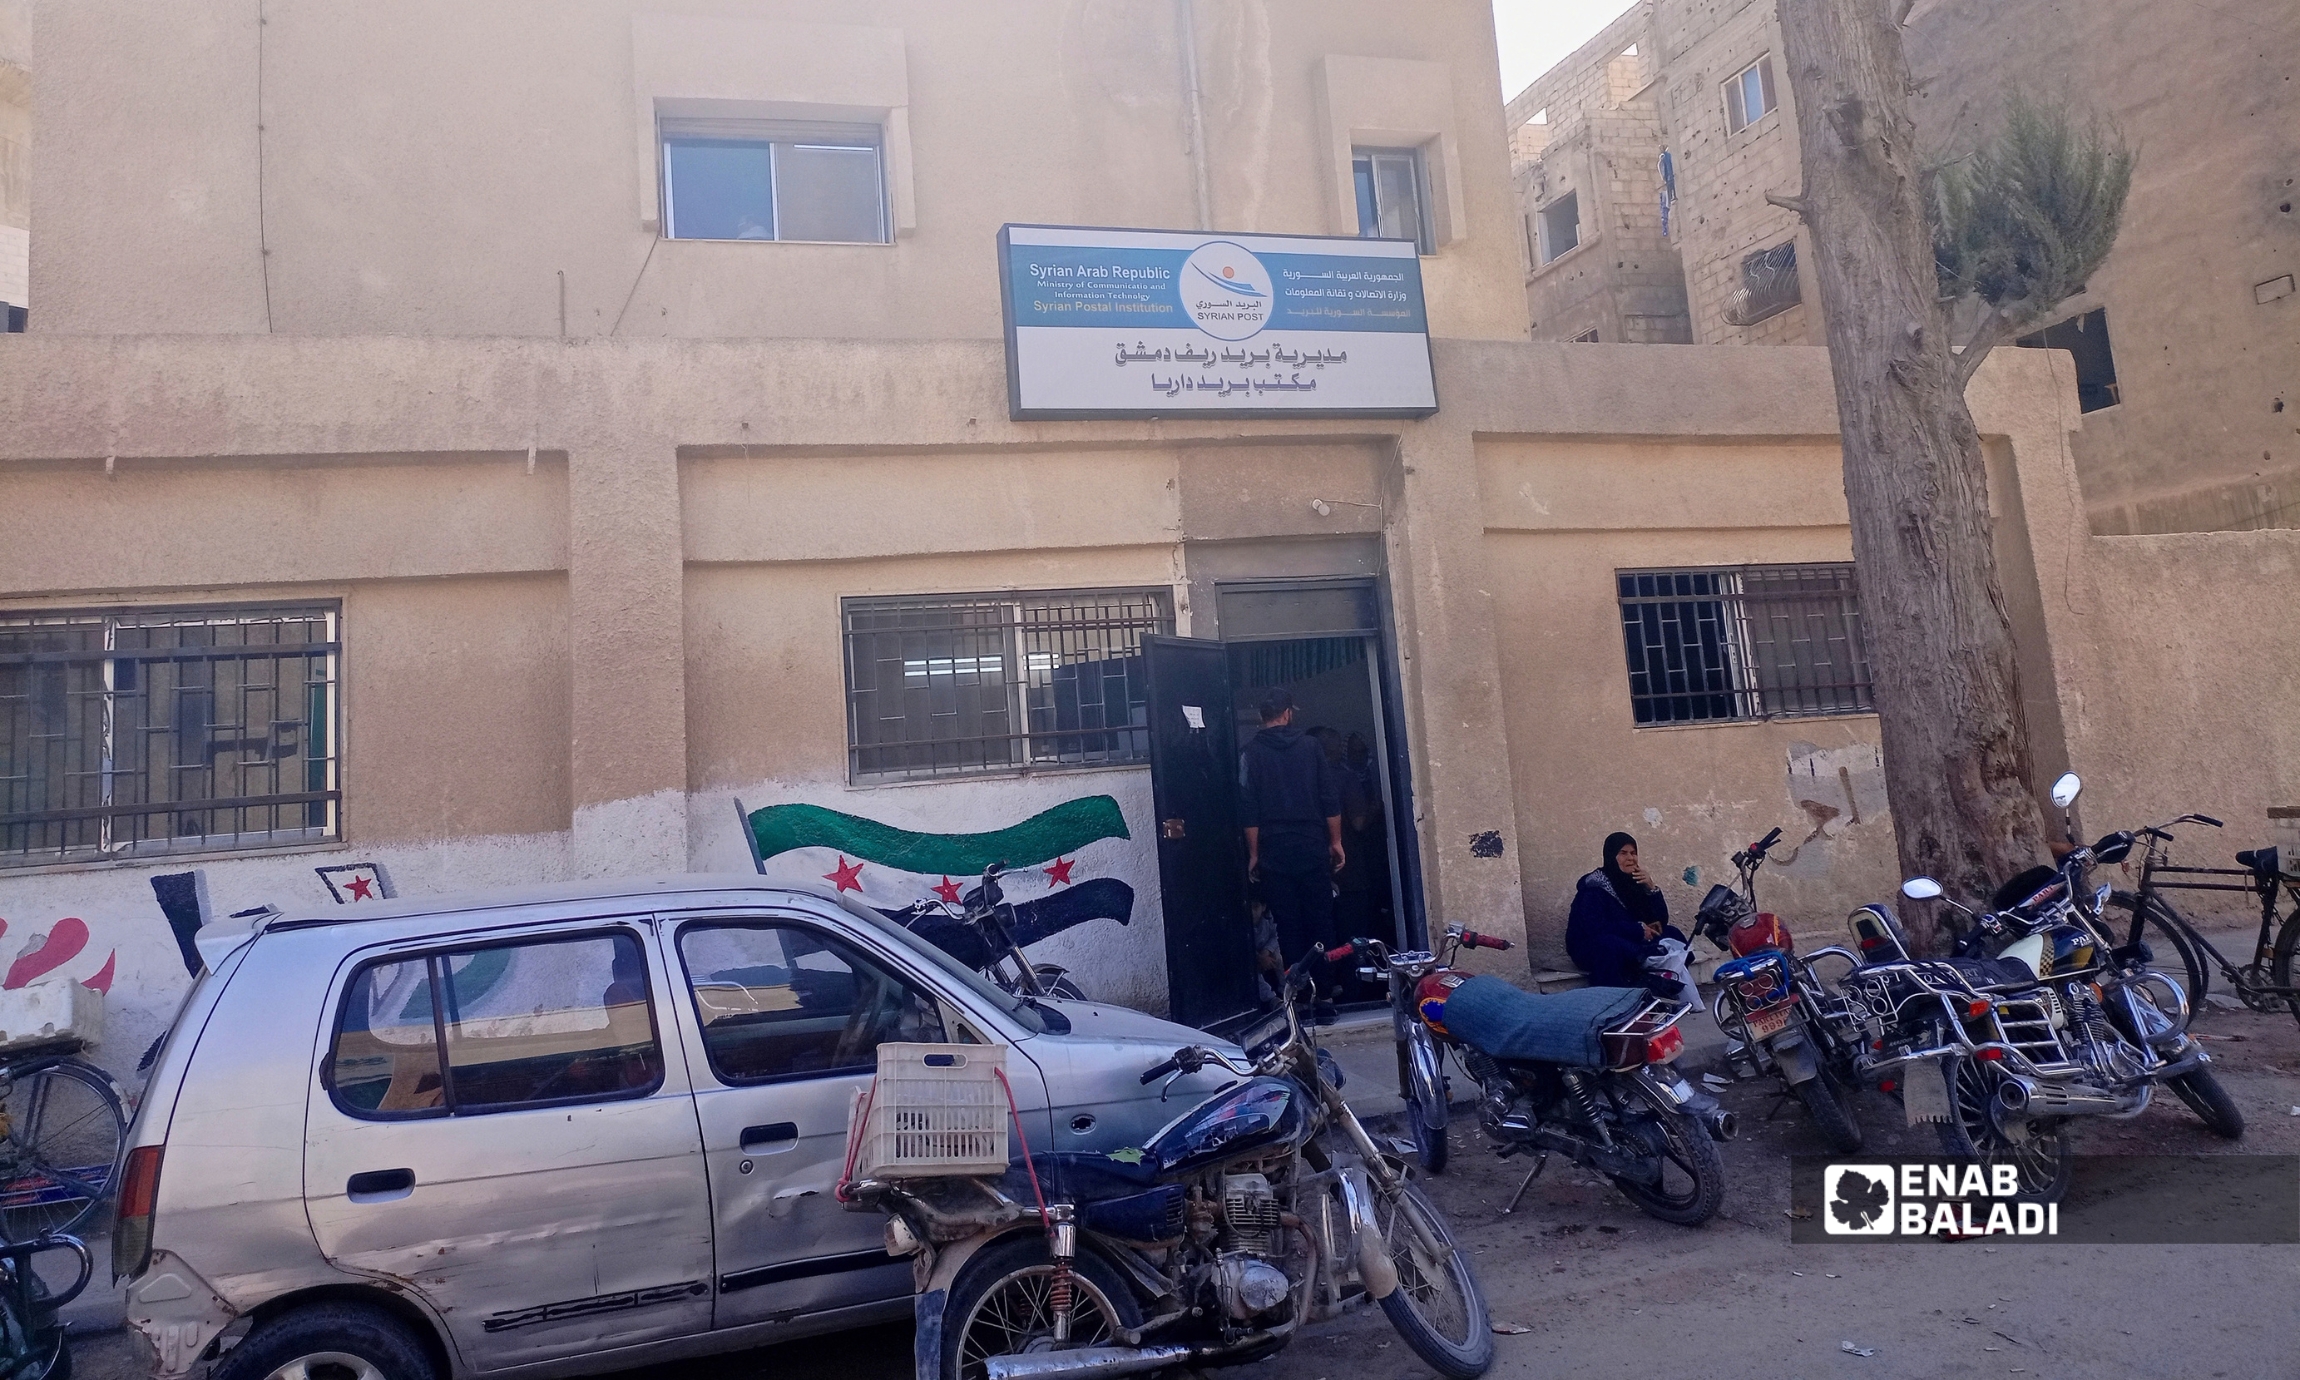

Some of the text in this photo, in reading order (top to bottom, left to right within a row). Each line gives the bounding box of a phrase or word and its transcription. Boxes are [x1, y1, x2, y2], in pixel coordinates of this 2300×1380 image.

[1030, 263, 1170, 281] Syrian Arab Republic
[1336, 270, 1361, 282] العربية
[1363, 271, 1404, 283] الجمهورية
[1037, 280, 1073, 290] Ministry
[1087, 281, 1148, 290] Communicatio
[1054, 290, 1150, 301] Information Technolgy
[1285, 288, 1324, 299] المعلومات
[1355, 289, 1386, 299] الاتصالات
[1388, 290, 1407, 302] وزارة
[1034, 300, 1173, 314] Syrian Postal Institution
[1196, 300, 1262, 310] البريد السوري
[1197, 312, 1264, 321] SYRIAN POST
[1115, 341, 1347, 369] مديرية بريد ريف دمشق
[1151, 373, 1318, 397] مكتب بريد داريا
